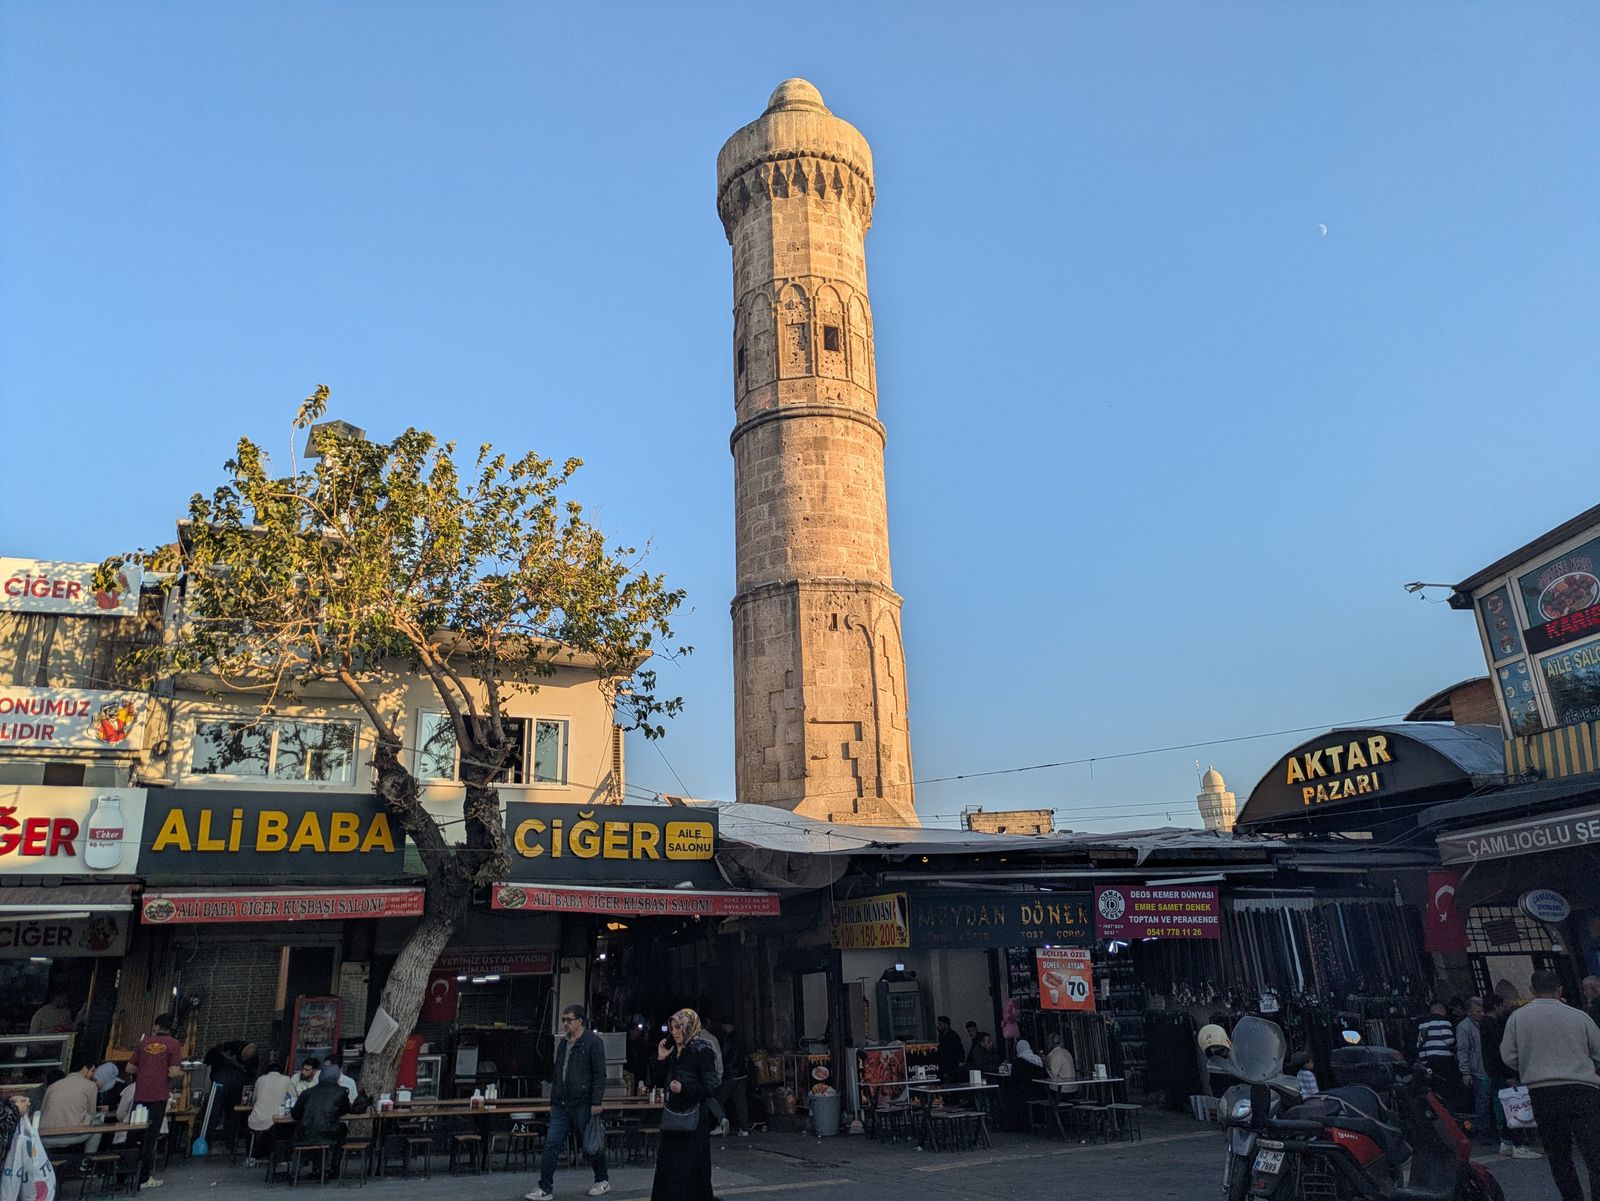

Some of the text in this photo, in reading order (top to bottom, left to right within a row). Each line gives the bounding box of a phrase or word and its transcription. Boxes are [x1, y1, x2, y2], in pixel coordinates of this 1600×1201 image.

[4, 574, 81, 599] CİĞER
[0, 697, 91, 717] ONUMUZ
[0, 722, 55, 740] LIDIR
[1286, 735, 1392, 785] AKTAR
[1302, 771, 1380, 805] PAZARI
[255, 810, 396, 853] BABA
[668, 843, 711, 853] SALONU
[1466, 824, 1571, 860] ÇAMLIOĞLU
[554, 894, 584, 908] BABA
[671, 898, 713, 912] SALONU
[1101, 891, 1123, 902] OSMAN
[1130, 889, 1214, 899] DEOS KEMER DÜNYASI
[202, 901, 237, 917] BABA
[282, 899, 335, 919] KUŞBAŞI
[338, 897, 387, 914] SALONU
[1021, 900, 1088, 926] DÖNER
[1101, 908, 1124, 919] DENEK
[1134, 903, 1212, 911] EMRE SAMET DENEK
[1128, 915, 1219, 924] TOPTAN VE PERAKENDE
[0, 920, 73, 947] CİĞER
[841, 926, 854, 947] 100
[880, 923, 896, 946] 200
[1146, 928, 1202, 936] 0541 778 11 26
[1068, 981, 1086, 996] 70
[1259, 1151, 1269, 1160] 63
